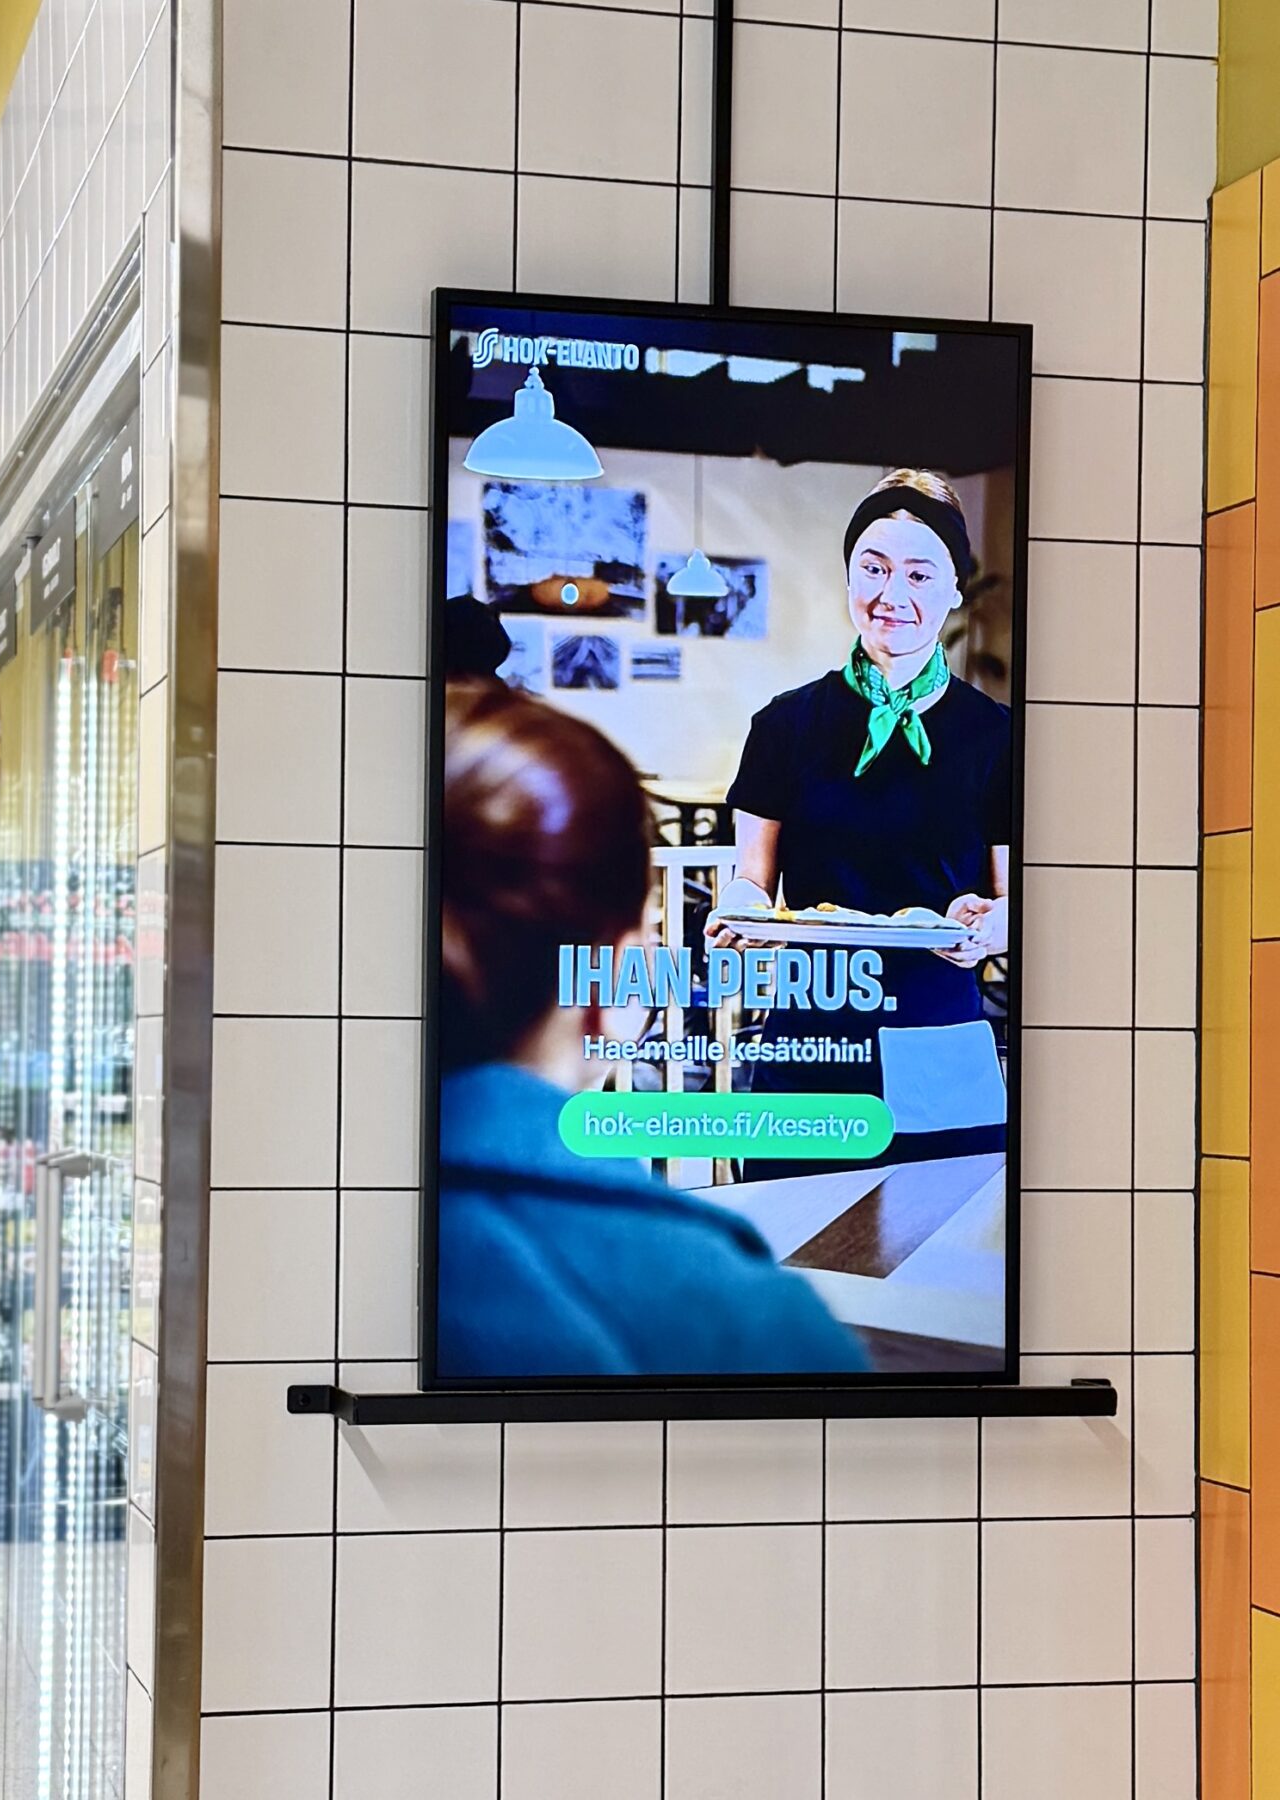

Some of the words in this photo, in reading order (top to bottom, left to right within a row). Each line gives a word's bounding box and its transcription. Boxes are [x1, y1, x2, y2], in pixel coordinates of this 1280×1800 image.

[502, 335, 640, 371] HOK-ELANTO
[558, 944, 692, 1008] IHAN
[708, 947, 897, 1012] PERUS.
[583, 1035, 637, 1061] Hae
[644, 1035, 724, 1061] meille
[729, 1036, 871, 1063] kesätöihin!
[583, 1110, 870, 1143] hok-elanto.fi/kesatyo
